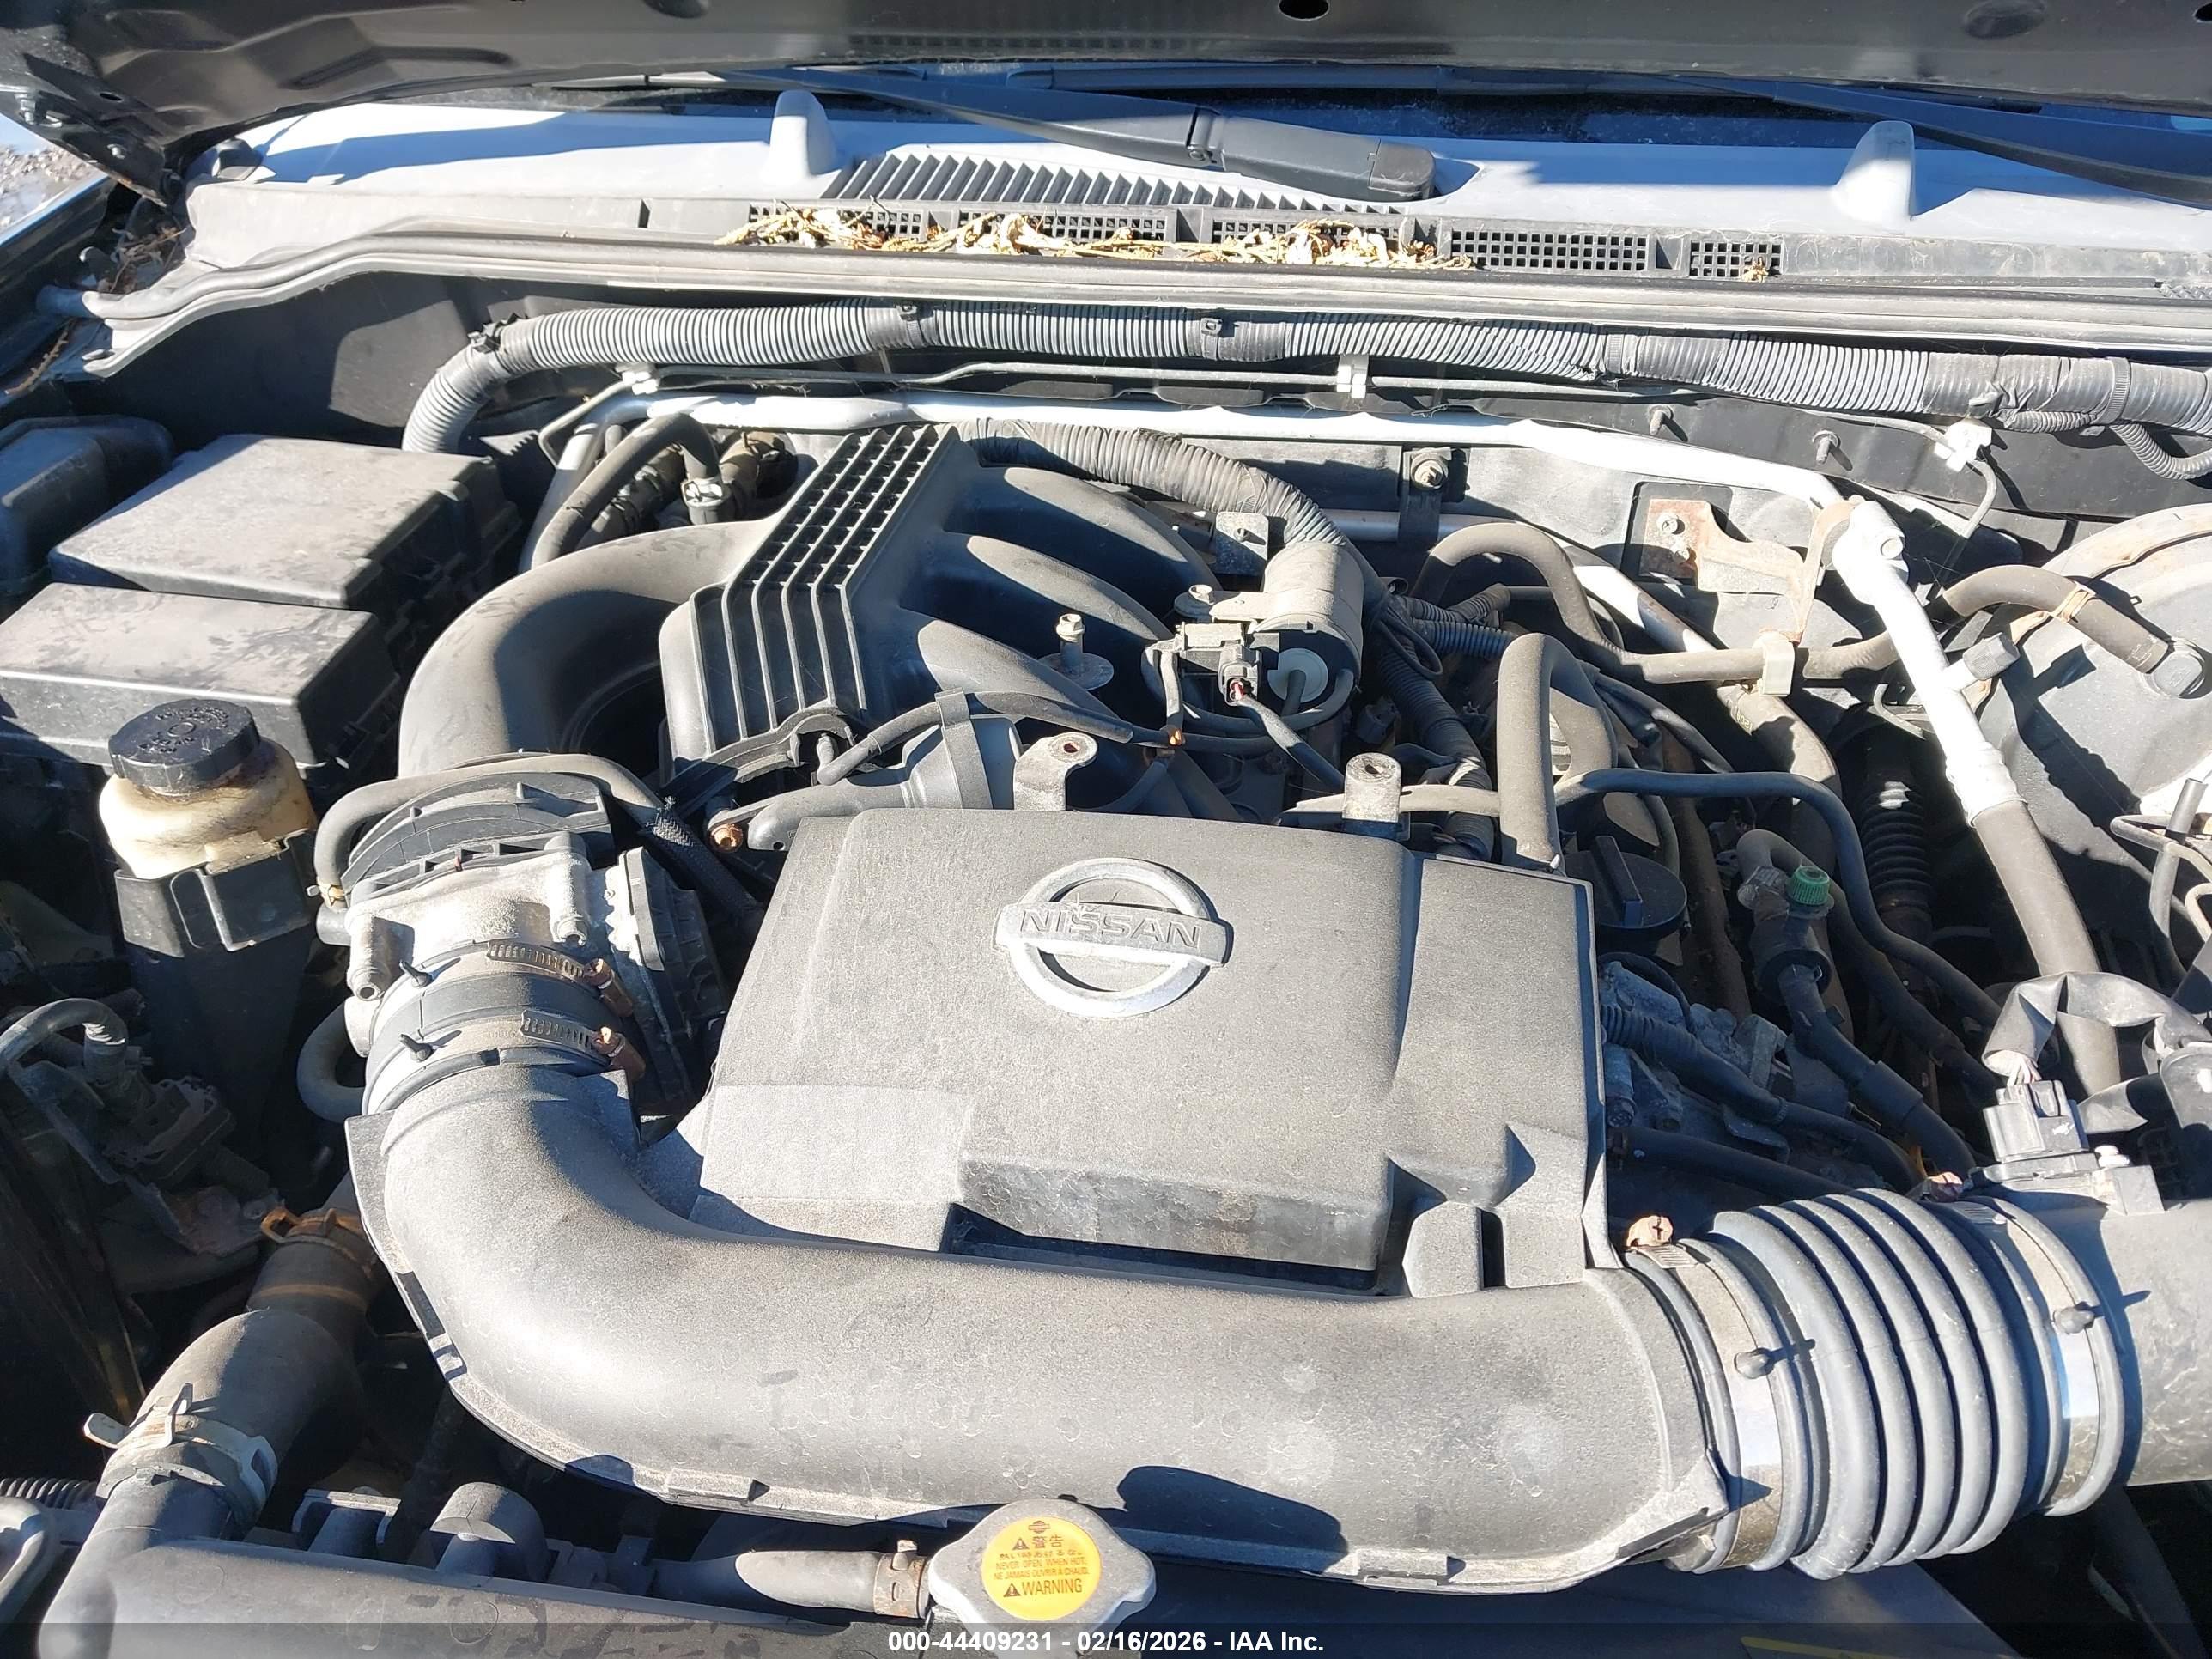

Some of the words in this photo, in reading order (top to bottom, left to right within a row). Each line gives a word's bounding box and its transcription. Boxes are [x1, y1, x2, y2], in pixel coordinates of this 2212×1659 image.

[1019, 908, 1202, 949] NISSAN
[1033, 1534, 1064, 1548] 警告
[996, 1561, 1019, 1571] NEVER
[1024, 1559, 1042, 1568] OPEN
[1046, 1558, 1068, 1566] WHEN
[994, 1571, 1004, 1581] NE
[1005, 1570, 1030, 1580] JAMAIS
[1033, 1568, 1057, 1578] OUVRIR
[1022, 1578, 1082, 1595] WARNING
